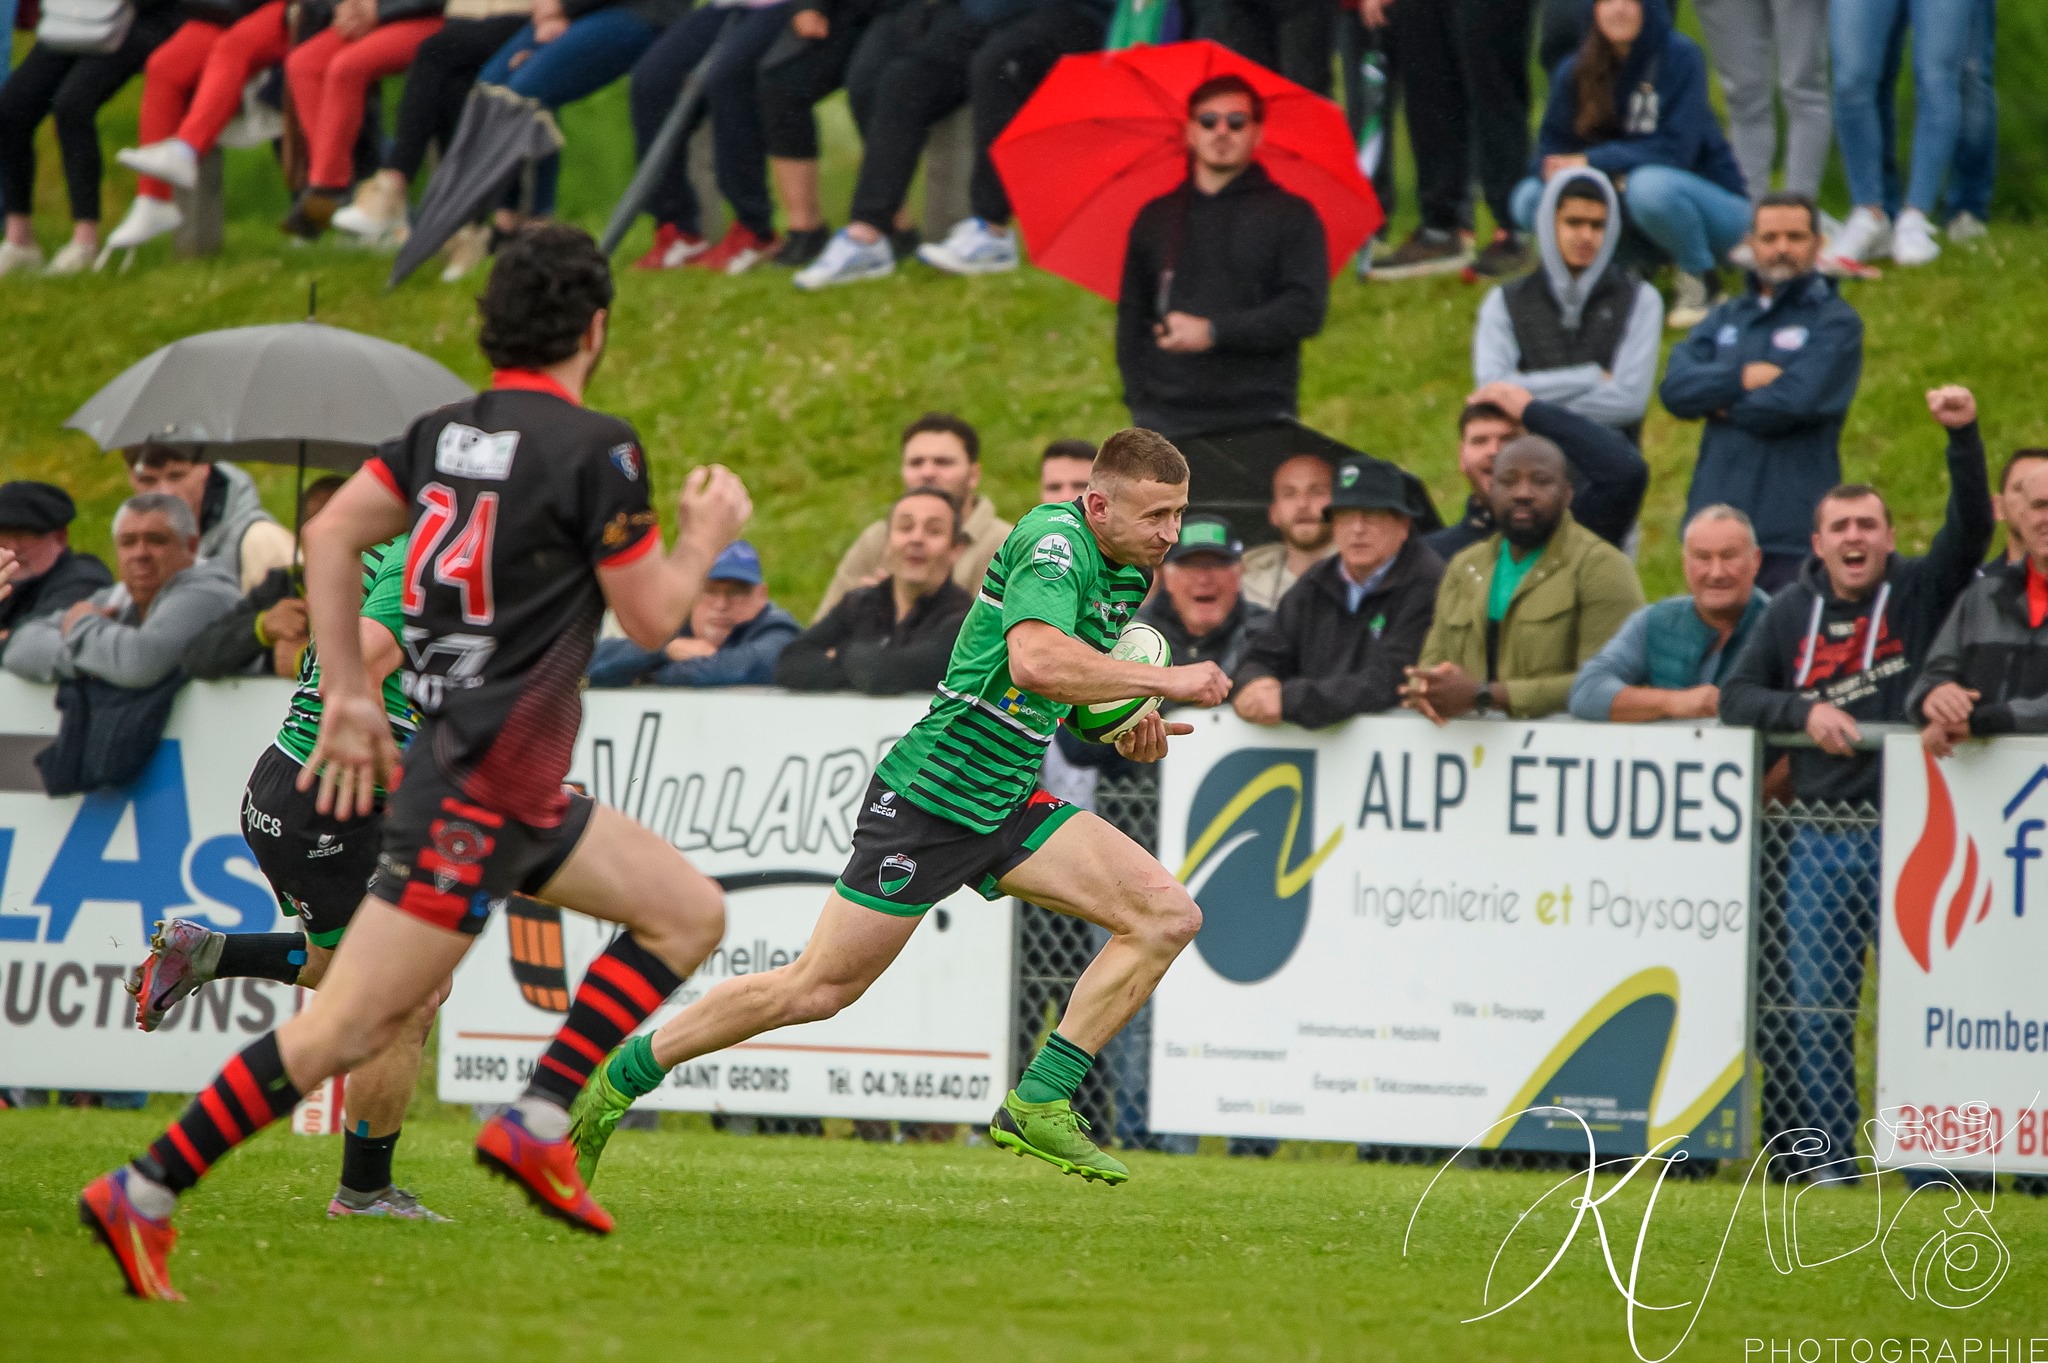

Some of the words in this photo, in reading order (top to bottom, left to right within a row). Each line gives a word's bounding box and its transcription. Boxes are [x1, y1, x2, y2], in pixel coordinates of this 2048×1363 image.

[402, 482, 500, 626] 14
[1509, 729, 1744, 843] ÉTUDES
[870, 802, 897, 819] JICEGA
[307, 843, 344, 859] JICEGA
[1353, 871, 1520, 927] Ingénierie
[1535, 883, 1574, 926] et
[1588, 878, 1743, 940] Paysage
[673, 1064, 719, 1089] SAINT
[727, 1066, 790, 1092] GEOIRS
